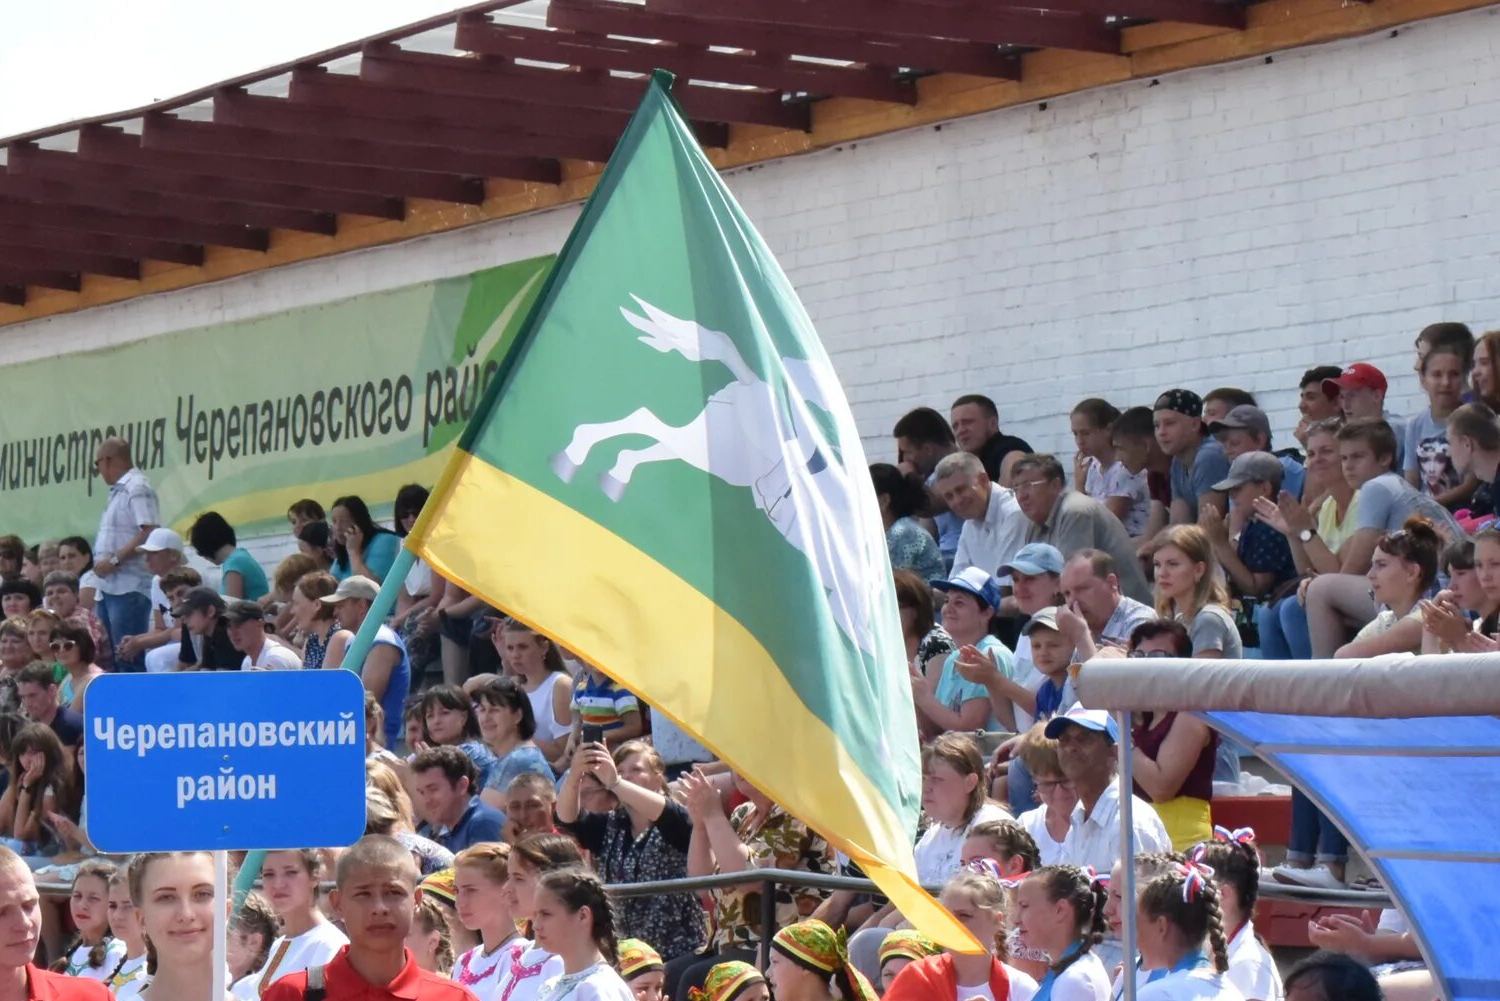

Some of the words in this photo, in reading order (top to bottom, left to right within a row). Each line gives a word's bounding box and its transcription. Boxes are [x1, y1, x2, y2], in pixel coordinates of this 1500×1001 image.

[176, 374, 413, 480] Черепановского
[93, 712, 356, 757] Черепановский
[177, 767, 276, 809] район
